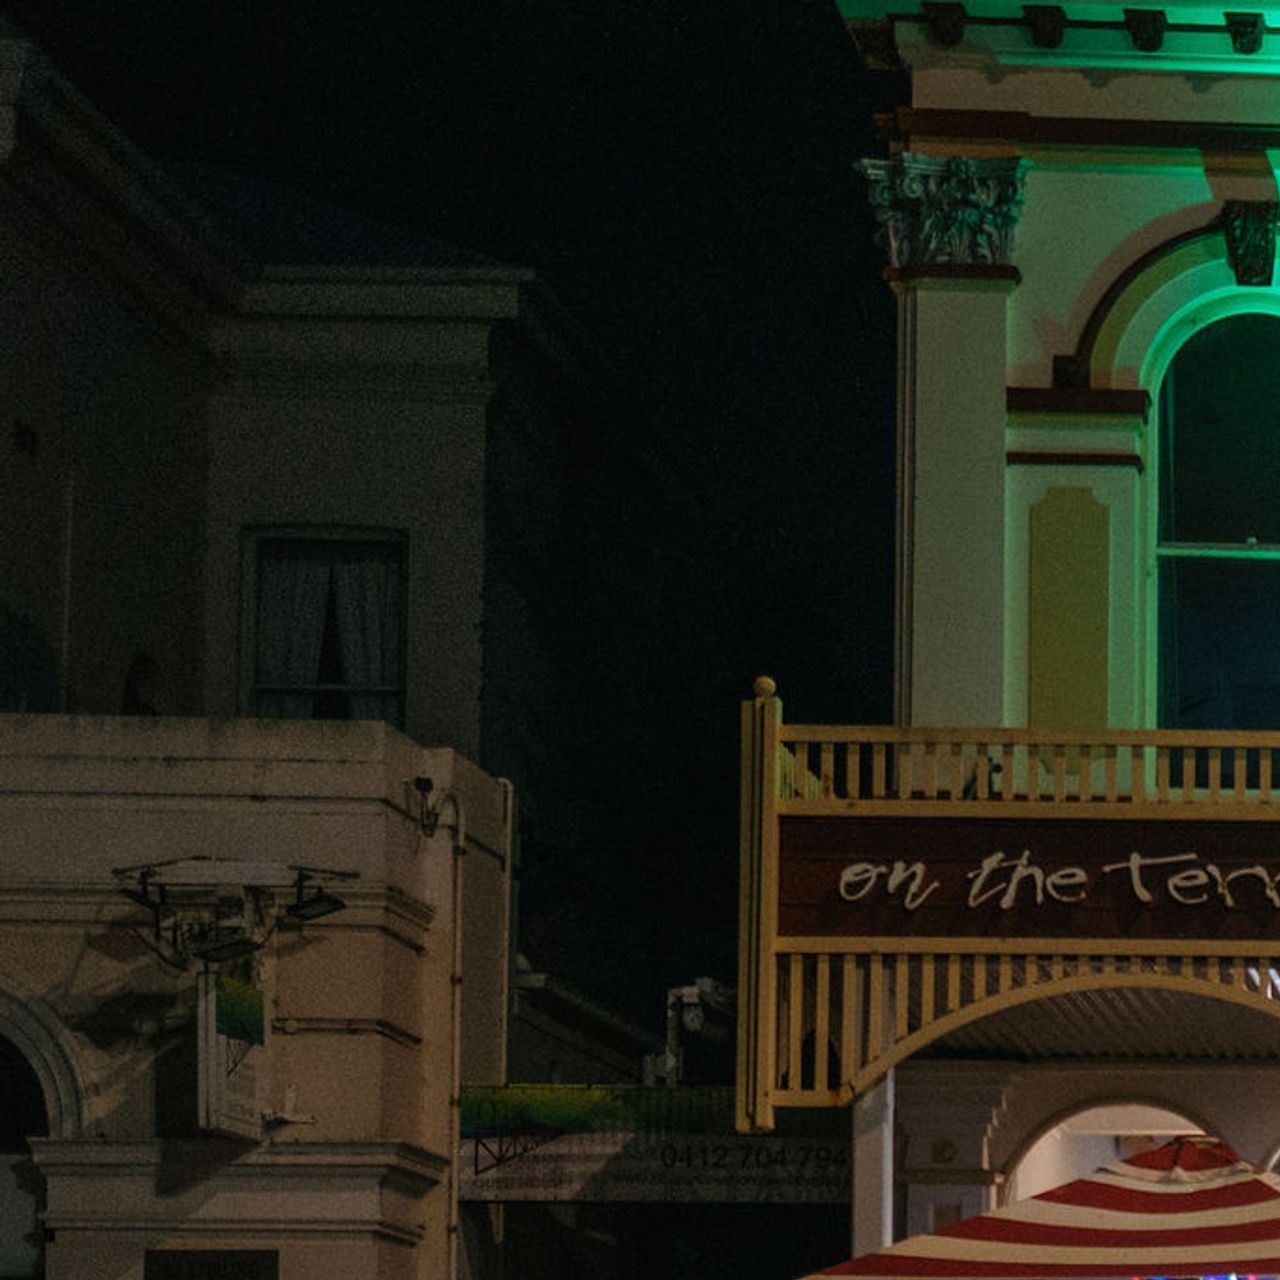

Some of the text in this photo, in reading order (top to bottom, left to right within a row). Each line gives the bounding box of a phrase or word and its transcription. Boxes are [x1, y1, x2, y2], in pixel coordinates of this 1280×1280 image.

[838, 855, 940, 909] on
[966, 851, 1088, 910] the
[660, 1144, 728, 1169] 0412
[738, 1144, 785, 1170] 704
